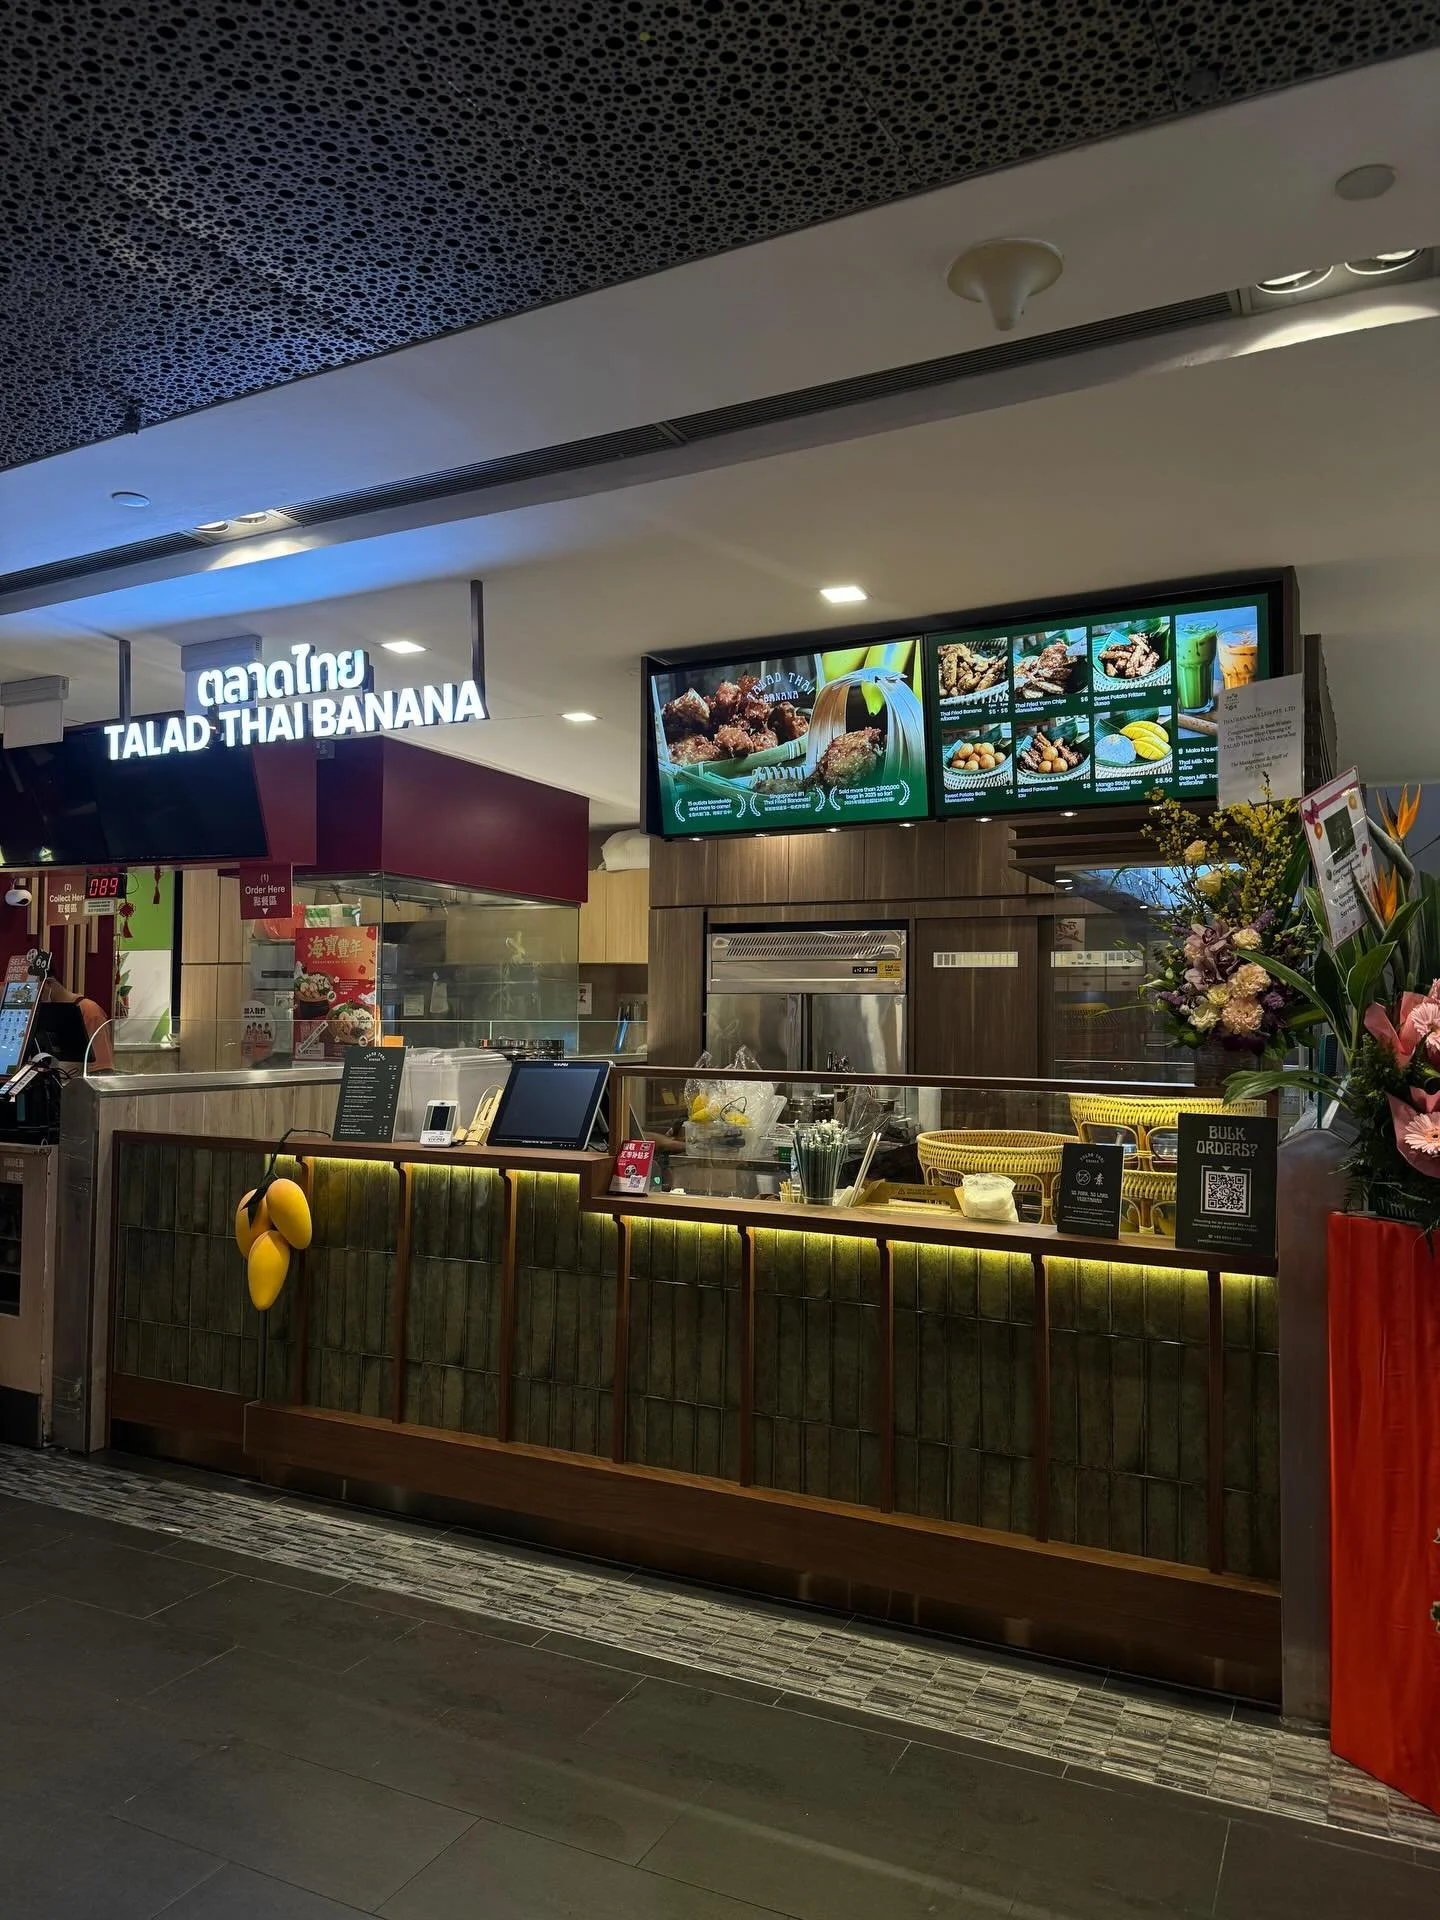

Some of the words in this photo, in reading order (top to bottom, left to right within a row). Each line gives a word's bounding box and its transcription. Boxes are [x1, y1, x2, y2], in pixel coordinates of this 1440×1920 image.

[197, 643, 366, 707] ตลาดไทย
[747, 672, 781, 702] TALAD
[788, 672, 815, 695] THAI
[763, 690, 799, 703] BANANA
[104, 714, 212, 760] TALAD
[219, 701, 304, 747] THAI
[312, 680, 487, 737] BANANA
[1032, 784, 1059, 792] Favourites
[1095, 781, 1114, 789] Mango
[1114, 779, 1131, 787] Sticky
[89, 878, 118, 896] 089
[245, 886, 266, 895] Order
[267, 884, 286, 894] Here
[49, 894, 71, 903] Collect
[1208, 1125, 1246, 1141] BULK
[1196, 1140, 1259, 1157] ORDERS?
